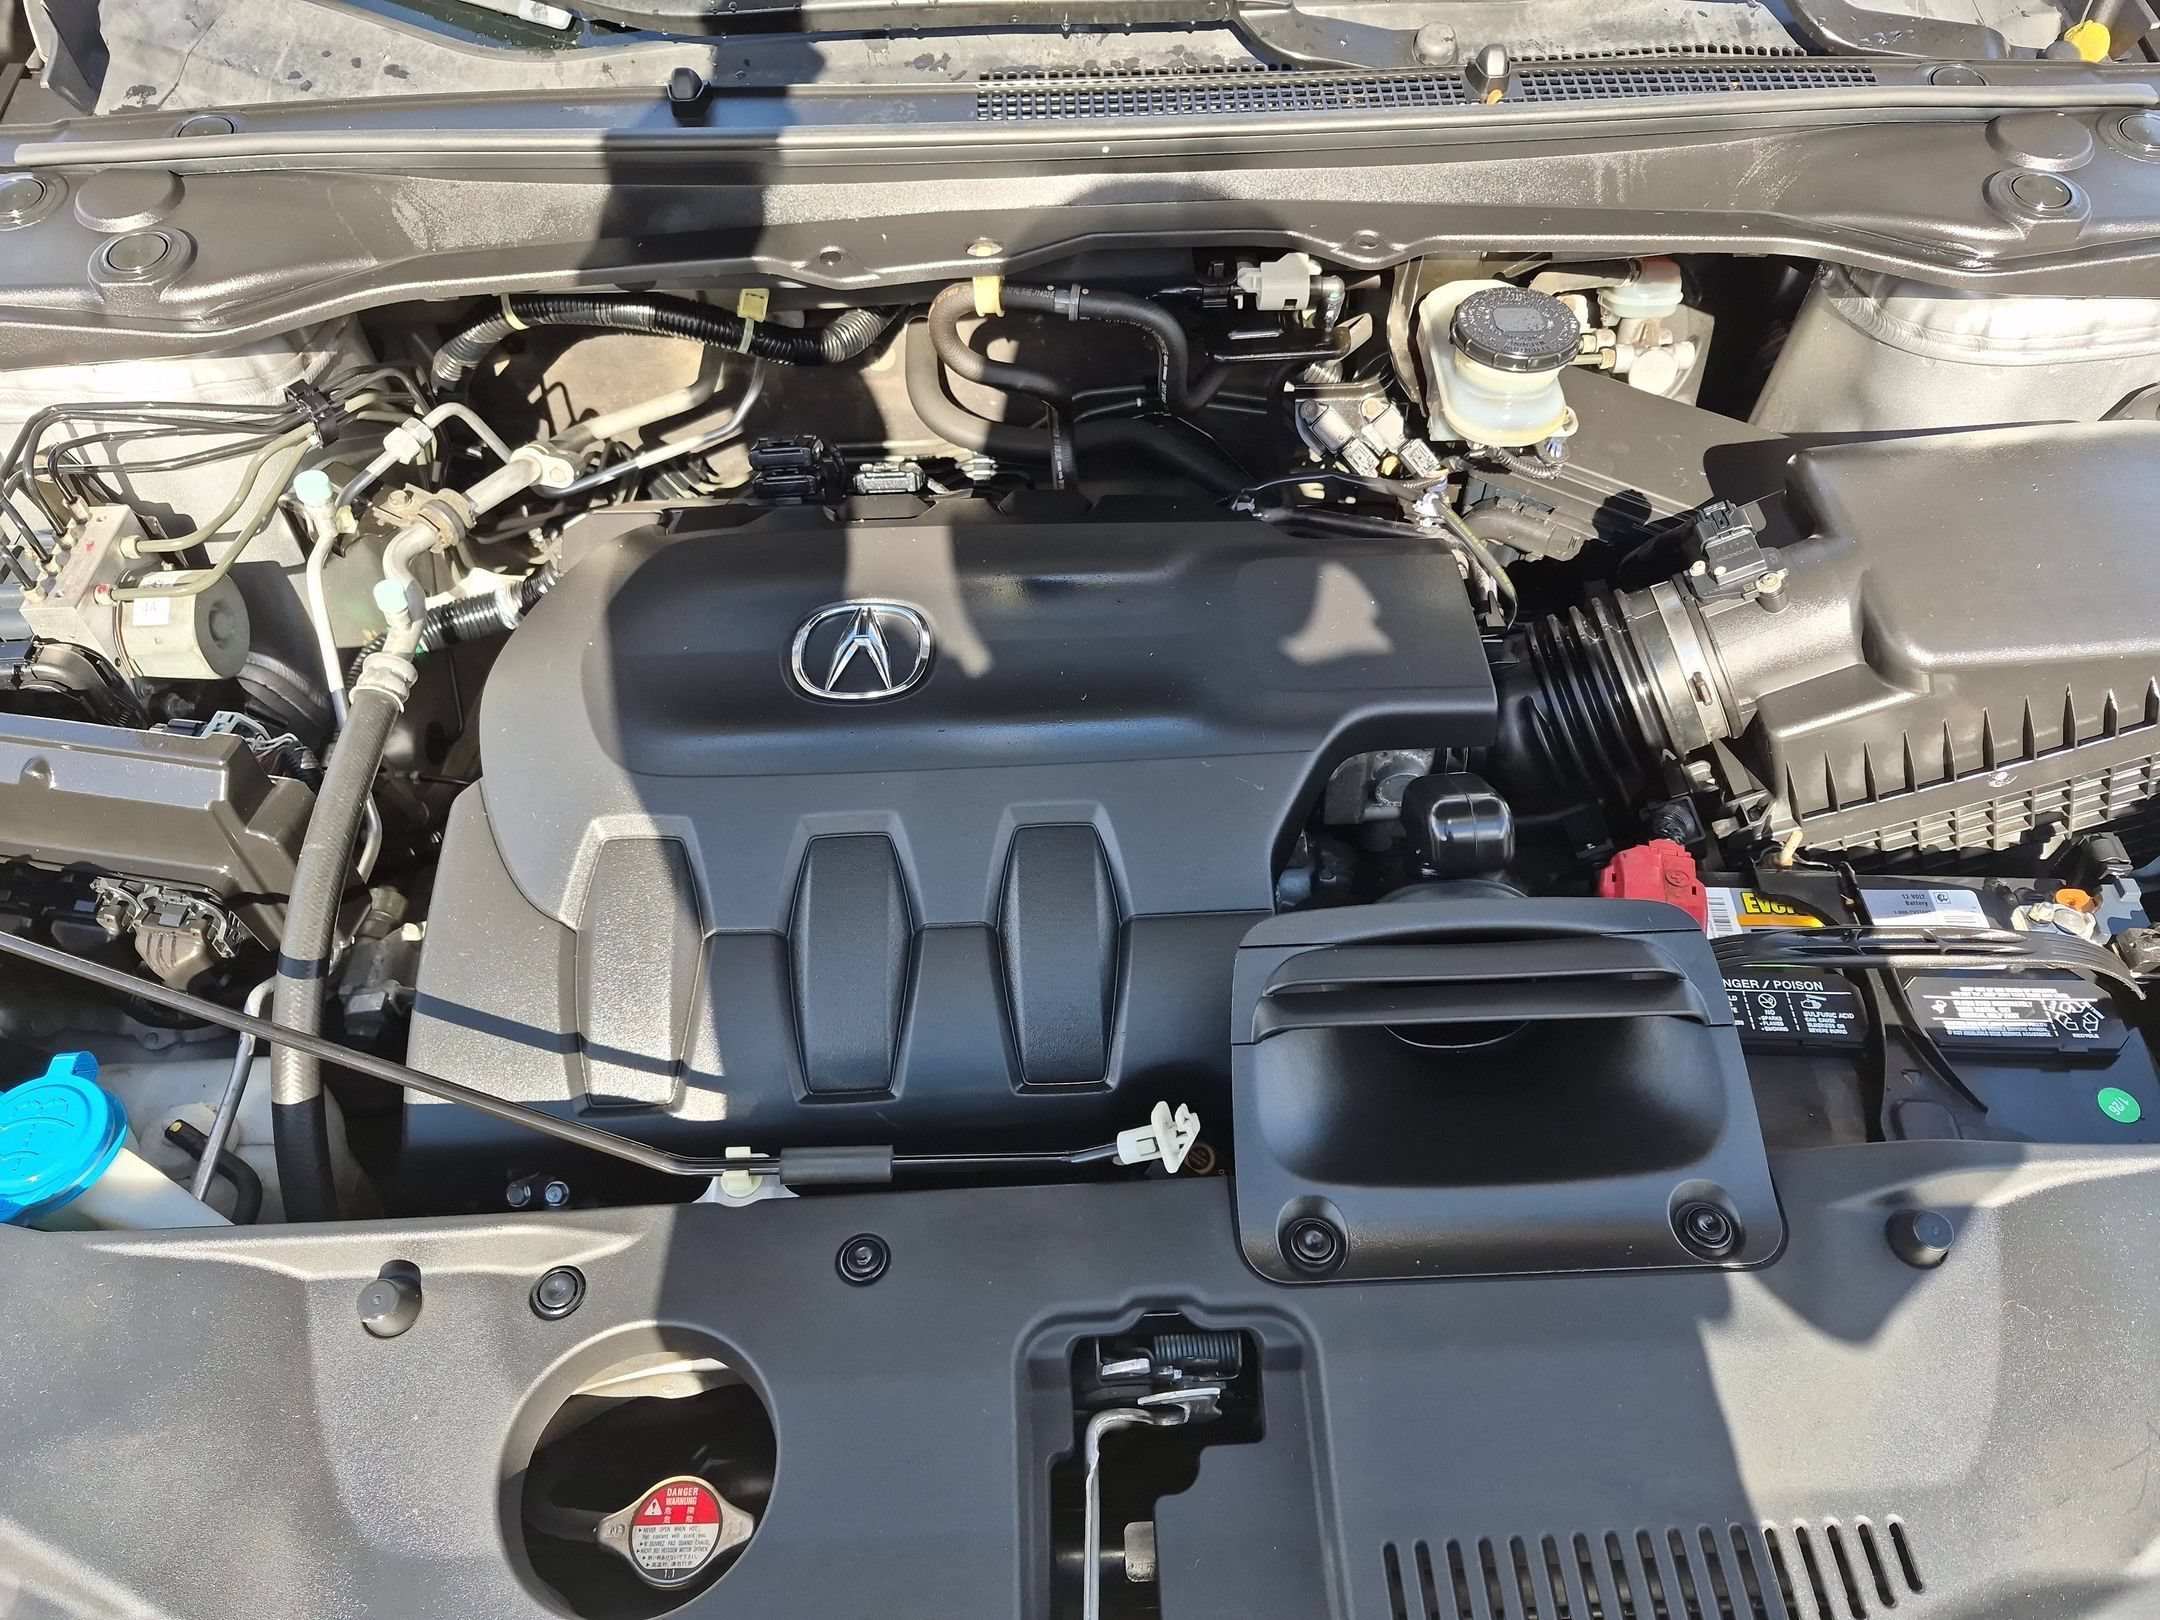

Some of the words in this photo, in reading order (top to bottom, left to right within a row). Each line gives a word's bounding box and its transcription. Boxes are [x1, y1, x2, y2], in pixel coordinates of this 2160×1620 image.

[1722, 979, 1760, 989] NGER
[1773, 981, 1824, 991] POISON
[1802, 1011, 1838, 1019] SULFURIC
[2108, 1096, 2129, 1116] 1/26
[666, 1487, 699, 1497] DANGER
[665, 1497, 697, 1506] WARNUNG
[663, 1569, 676, 1578] 1.1
